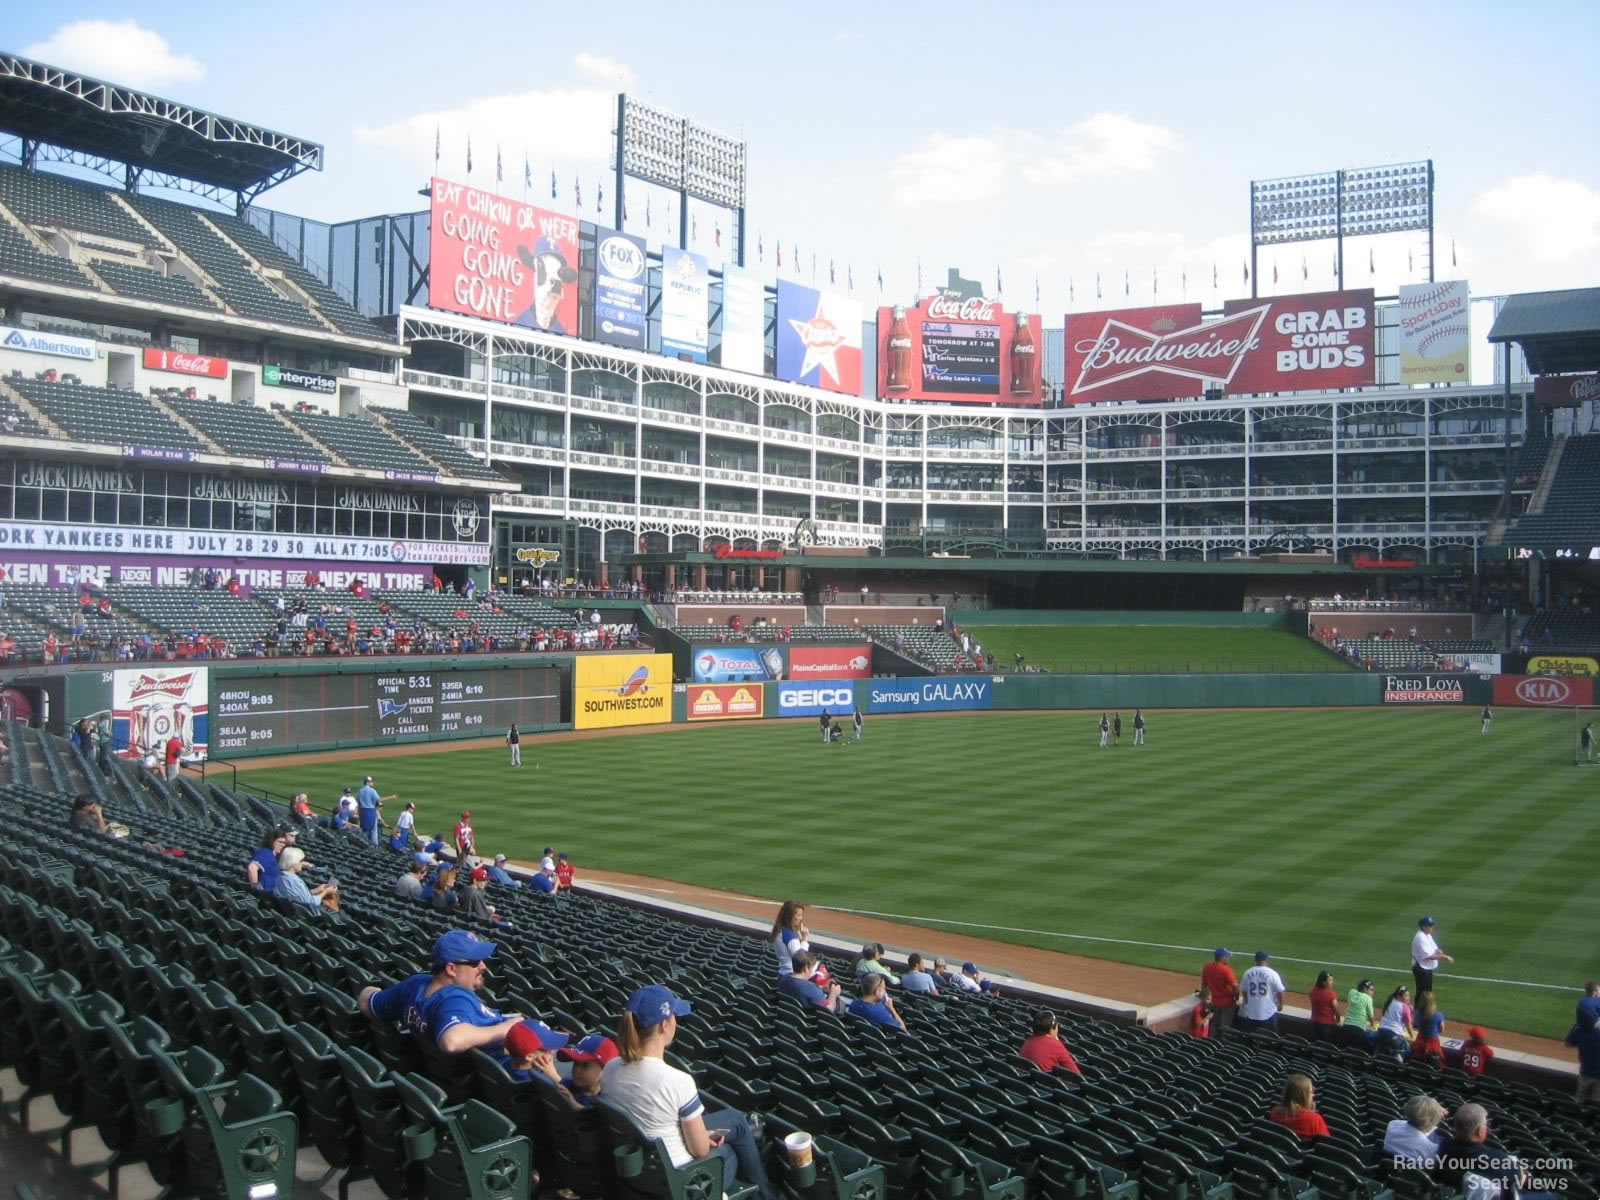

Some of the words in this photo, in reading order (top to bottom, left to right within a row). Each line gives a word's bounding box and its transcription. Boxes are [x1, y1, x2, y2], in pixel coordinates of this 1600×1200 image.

[435, 182, 463, 206] EAT
[467, 189, 512, 225] CHIKIN
[517, 208, 535, 231] OR
[539, 217, 577, 246] WEER
[442, 210, 499, 250] GOING
[610, 244, 633, 264] FOX
[463, 245, 523, 286] GOING
[670, 280, 703, 294] REPUBLIC
[943, 289, 962, 297] Enjoy
[454, 274, 515, 319] GONE
[928, 295, 996, 321] Coca-Cola
[1401, 296, 1461, 329] SportsDay
[1275, 307, 1366, 335] GRAB
[28, 337, 91, 357] Albertsons
[928, 338, 967, 346] TOMORROW
[1291, 330, 1349, 348] SOME
[1074, 332, 1260, 370] Budweiser
[1276, 345, 1365, 372] BUDS
[266, 369, 336, 388] enterprise
[122, 446, 134, 456] 34
[140, 449, 163, 457] NOLAN
[165, 451, 183, 459] RYAN
[189, 452, 200, 462] 34
[265, 459, 275, 469] 26
[277, 462, 299, 470] JOHNNY
[22, 462, 67, 487] JACK
[195, 476, 232, 499] JACK
[340, 486, 371, 508] JACK
[0, 528, 35, 545] ORK
[44, 529, 123, 547] YANKEES
[132, 533, 173, 549] HERE
[188, 536, 227, 551] JULY
[236, 538, 253, 552] 28
[262, 539, 278, 553] 29
[287, 541, 303, 554] 30
[314, 542, 337, 555] ALL
[341, 543, 357, 556] AT
[362, 544, 388, 558] 7:05
[408, 552, 488, 564] texasrangers.com
[236, 568, 283, 587] TIRE
[319, 571, 381, 589] NEXEN
[384, 574, 424, 589] TIRE
[792, 663, 848, 672] PlainsCapitalBank
[1537, 659, 1589, 671] Chicken
[102, 672, 113, 682] 354
[128, 678, 192, 692] Budweiser
[377, 678, 406, 686] OFFICIAL
[408, 676, 432, 688] 5:31
[1386, 676, 1421, 690] FRED
[1426, 675, 1462, 690] LOYA
[384, 685, 399, 693] TIME
[466, 685, 483, 694] 6:10
[674, 685, 686, 693] 390
[872, 691, 919, 704] Samsung
[923, 684, 986, 701] GALAXY
[1386, 691, 1461, 701] INSURANCE
[1525, 683, 1560, 699] KIA
[251, 695, 273, 705] 9:05
[408, 697, 434, 705] RANGERS
[584, 697, 664, 713] SOUTHWEST.COM
[780, 688, 852, 707] GEICO
[409, 706, 432, 714] TICKETS
[465, 715, 482, 724] 6:10
[251, 729, 273, 739] 9:05
[382, 725, 429, 735] 972-RANGERS
[1249, 981, 1268, 997] 25
[1464, 1054, 1479, 1067] 29
